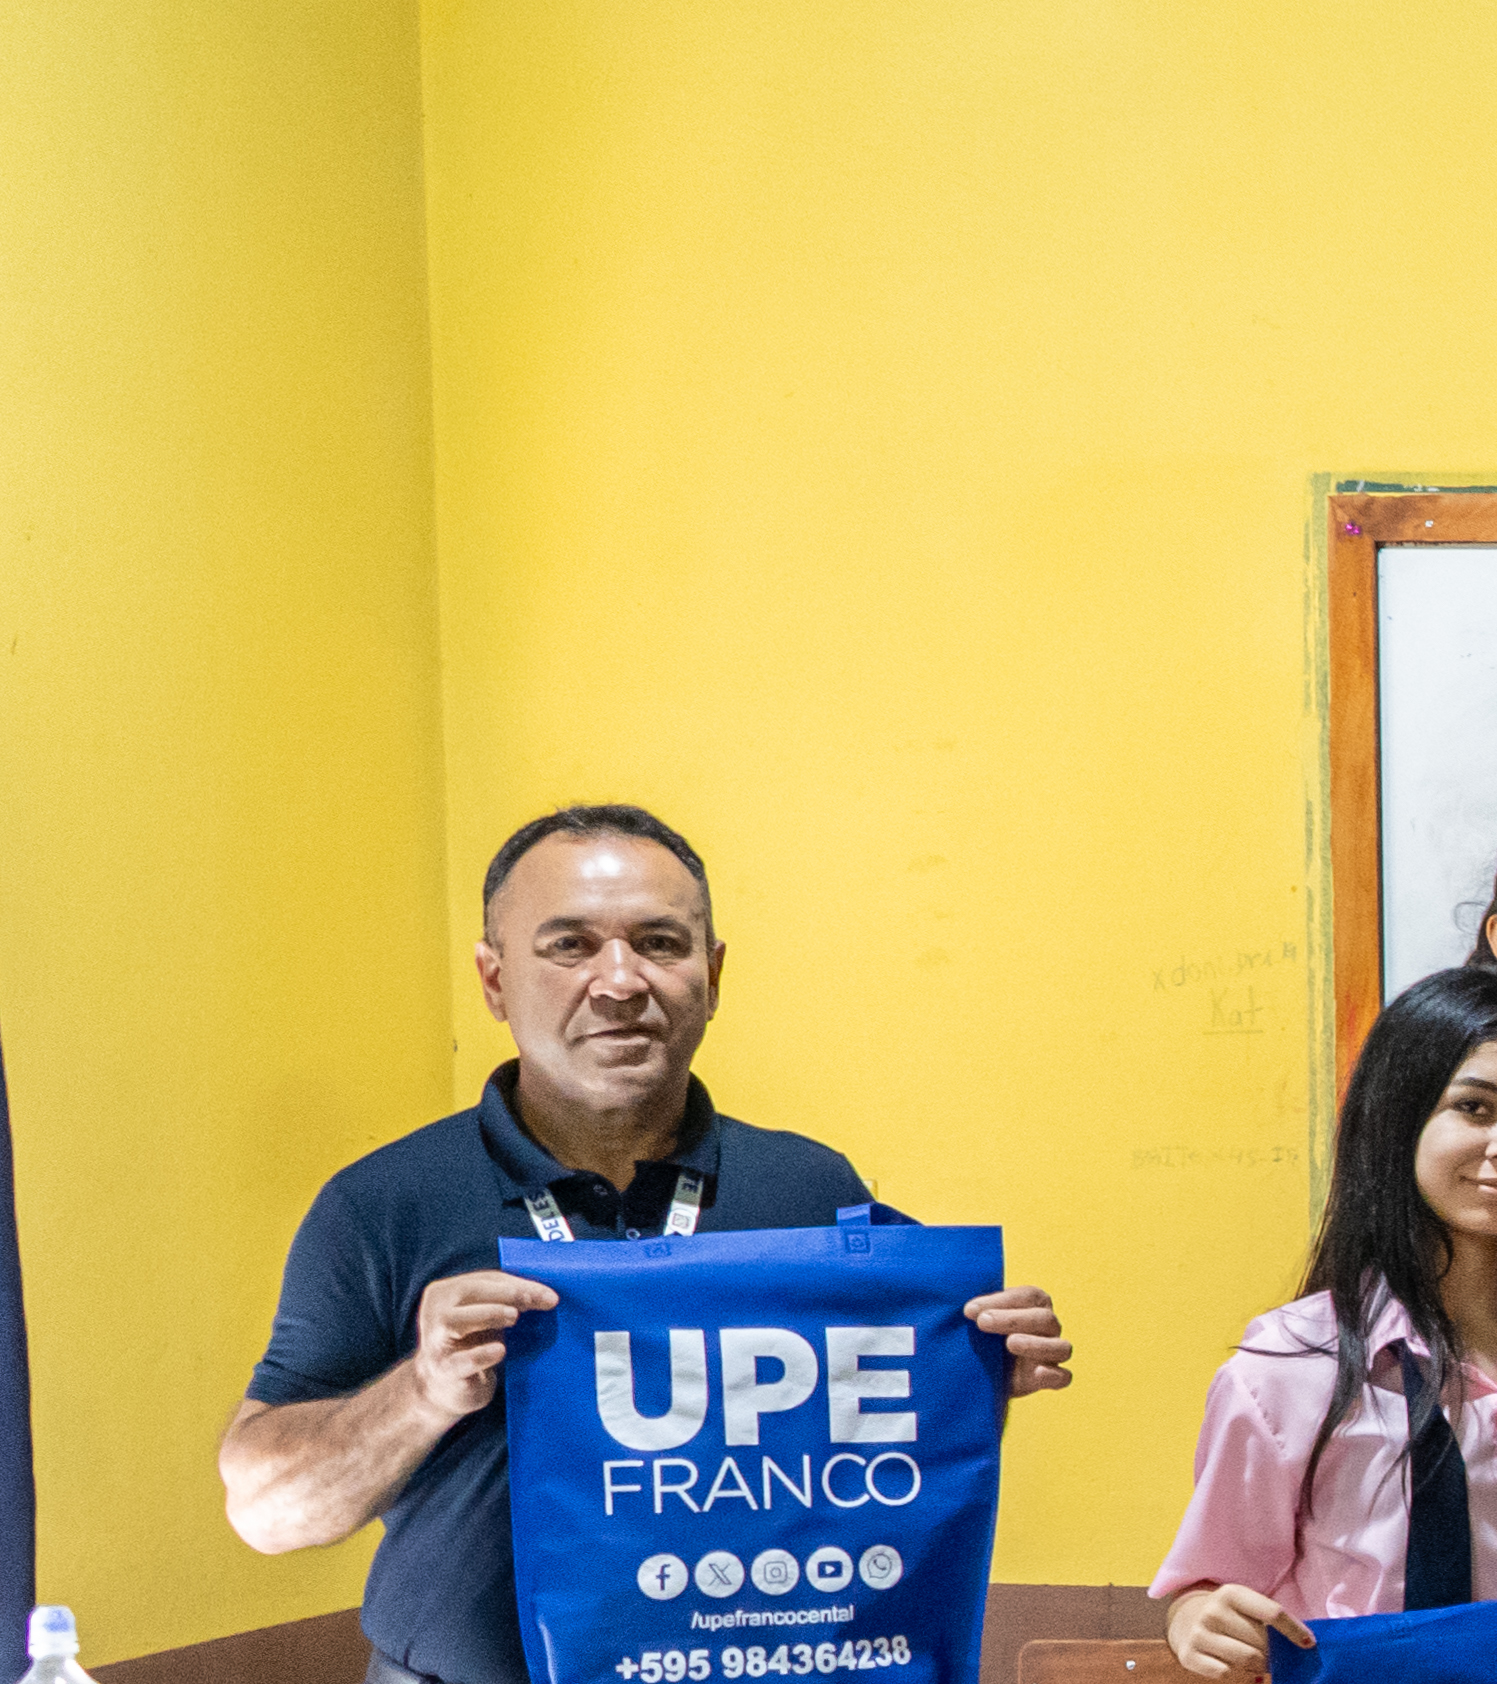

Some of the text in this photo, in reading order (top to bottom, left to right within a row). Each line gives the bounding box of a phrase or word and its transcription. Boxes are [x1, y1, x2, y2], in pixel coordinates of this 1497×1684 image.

[594, 1326, 916, 1451] UPE
[603, 1452, 921, 1516] FRANCO
[691, 1605, 854, 1631] /upefrancocental
[616, 1636, 912, 1684] +595 984364238
